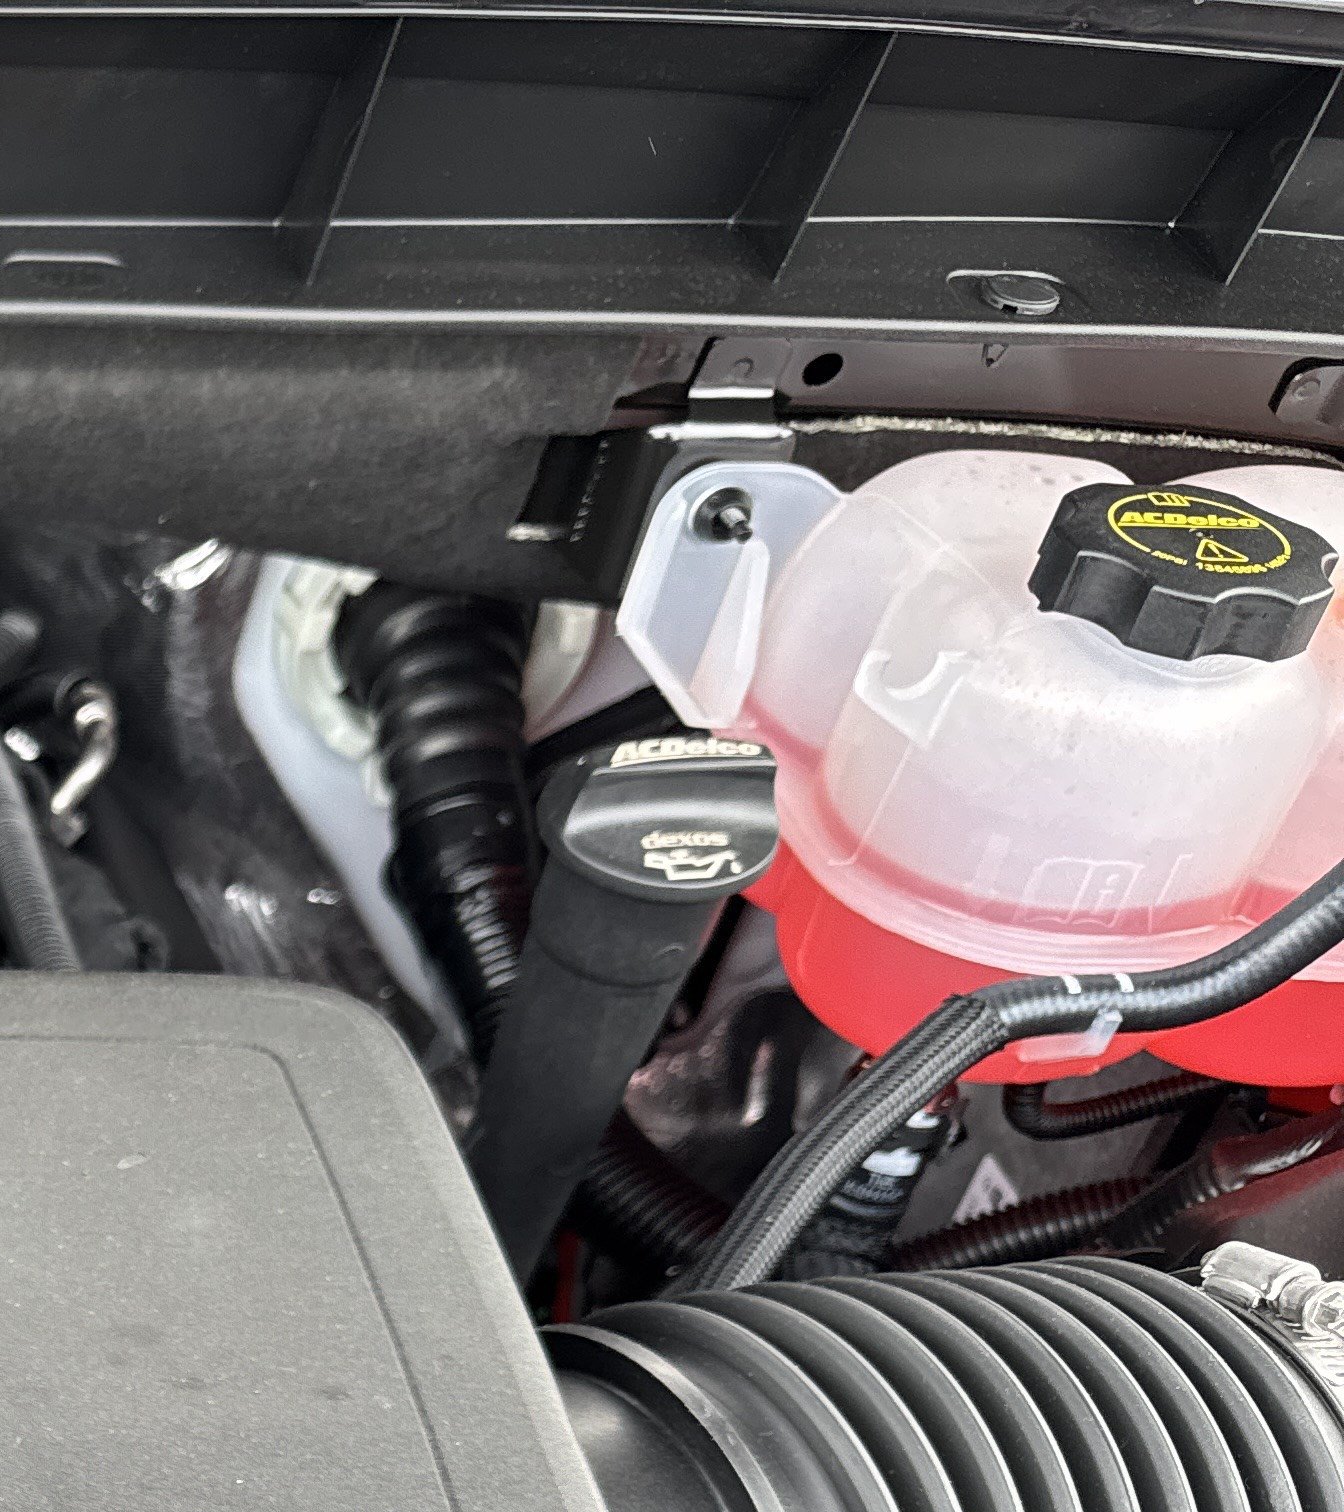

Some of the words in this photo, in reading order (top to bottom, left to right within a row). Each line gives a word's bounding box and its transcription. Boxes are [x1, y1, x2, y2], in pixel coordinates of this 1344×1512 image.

[1118, 511, 1260, 529] ACDelco
[610, 737, 762, 763] ACDelco
[640, 830, 730, 850] dexos
